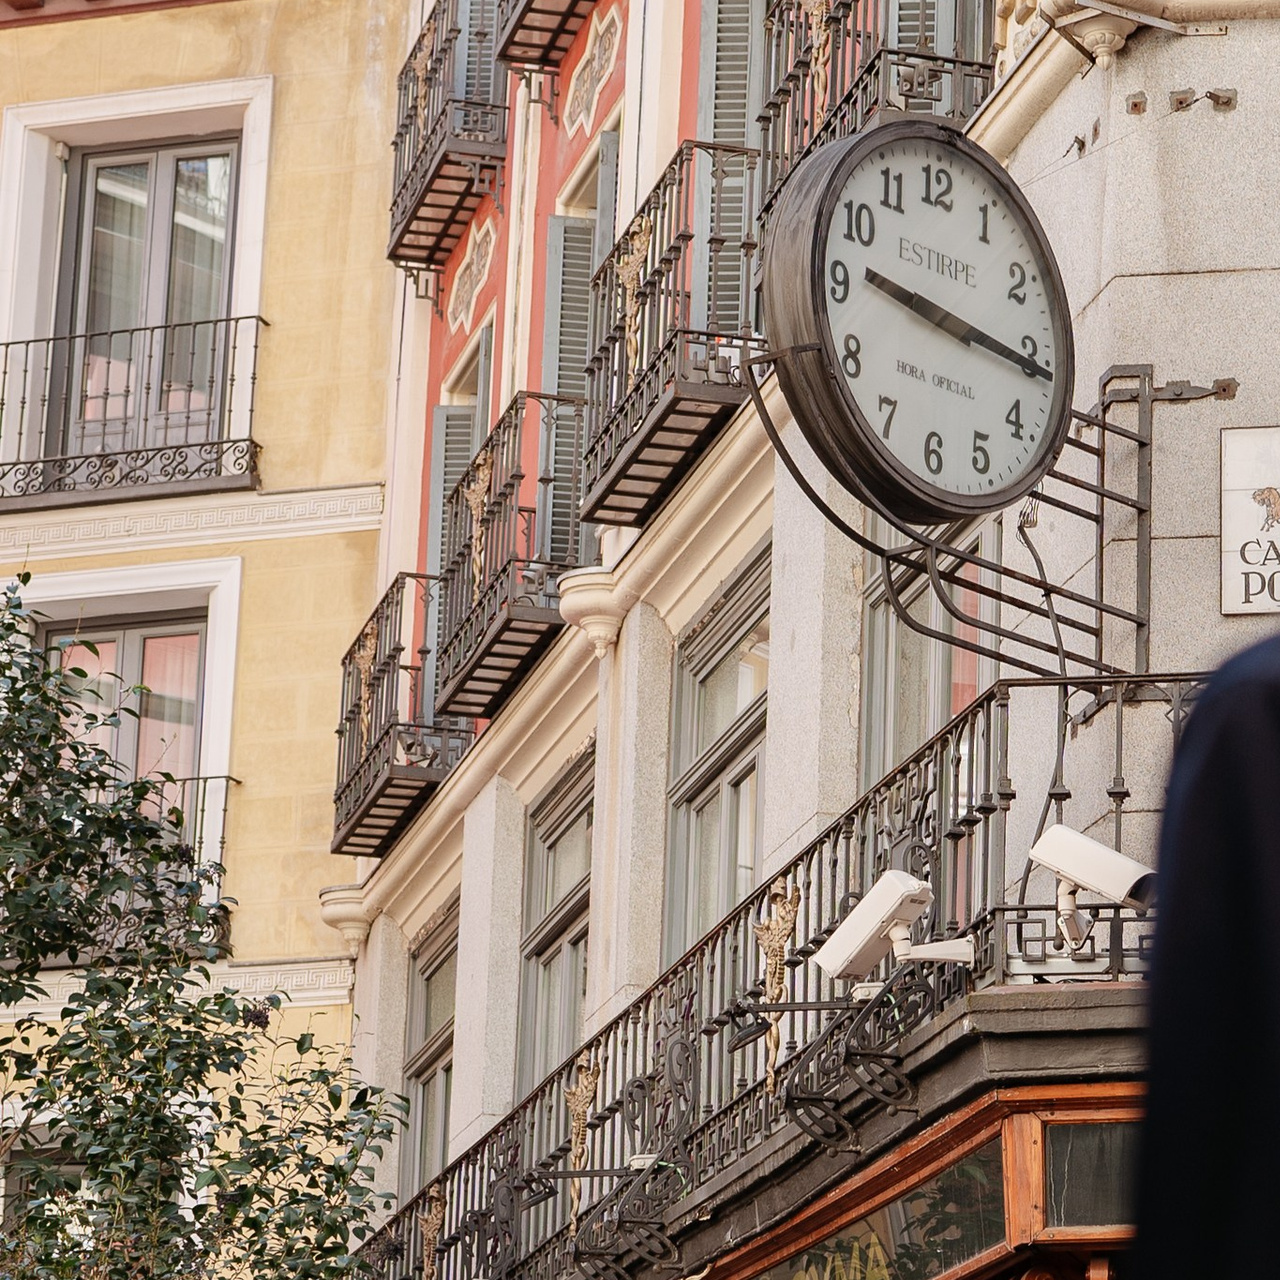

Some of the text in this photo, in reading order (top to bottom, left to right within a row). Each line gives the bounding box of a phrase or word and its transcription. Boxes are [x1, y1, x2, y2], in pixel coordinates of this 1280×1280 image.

[880, 167, 905, 215] 11
[921, 164, 953, 213] 12
[843, 199, 875, 247] 10
[979, 203, 990, 245] 1
[830, 260, 850, 304] 9
[898, 237, 977, 289] ESTIRPE
[1007, 262, 1027, 306] 2
[842, 334, 862, 379] 8
[896, 359, 976, 400] HORA OFICIAL
[878, 394, 898, 440] 7
[1005, 398, 1024, 441] 4
[924, 431, 943, 475] 6
[972, 430, 990, 475] 5
